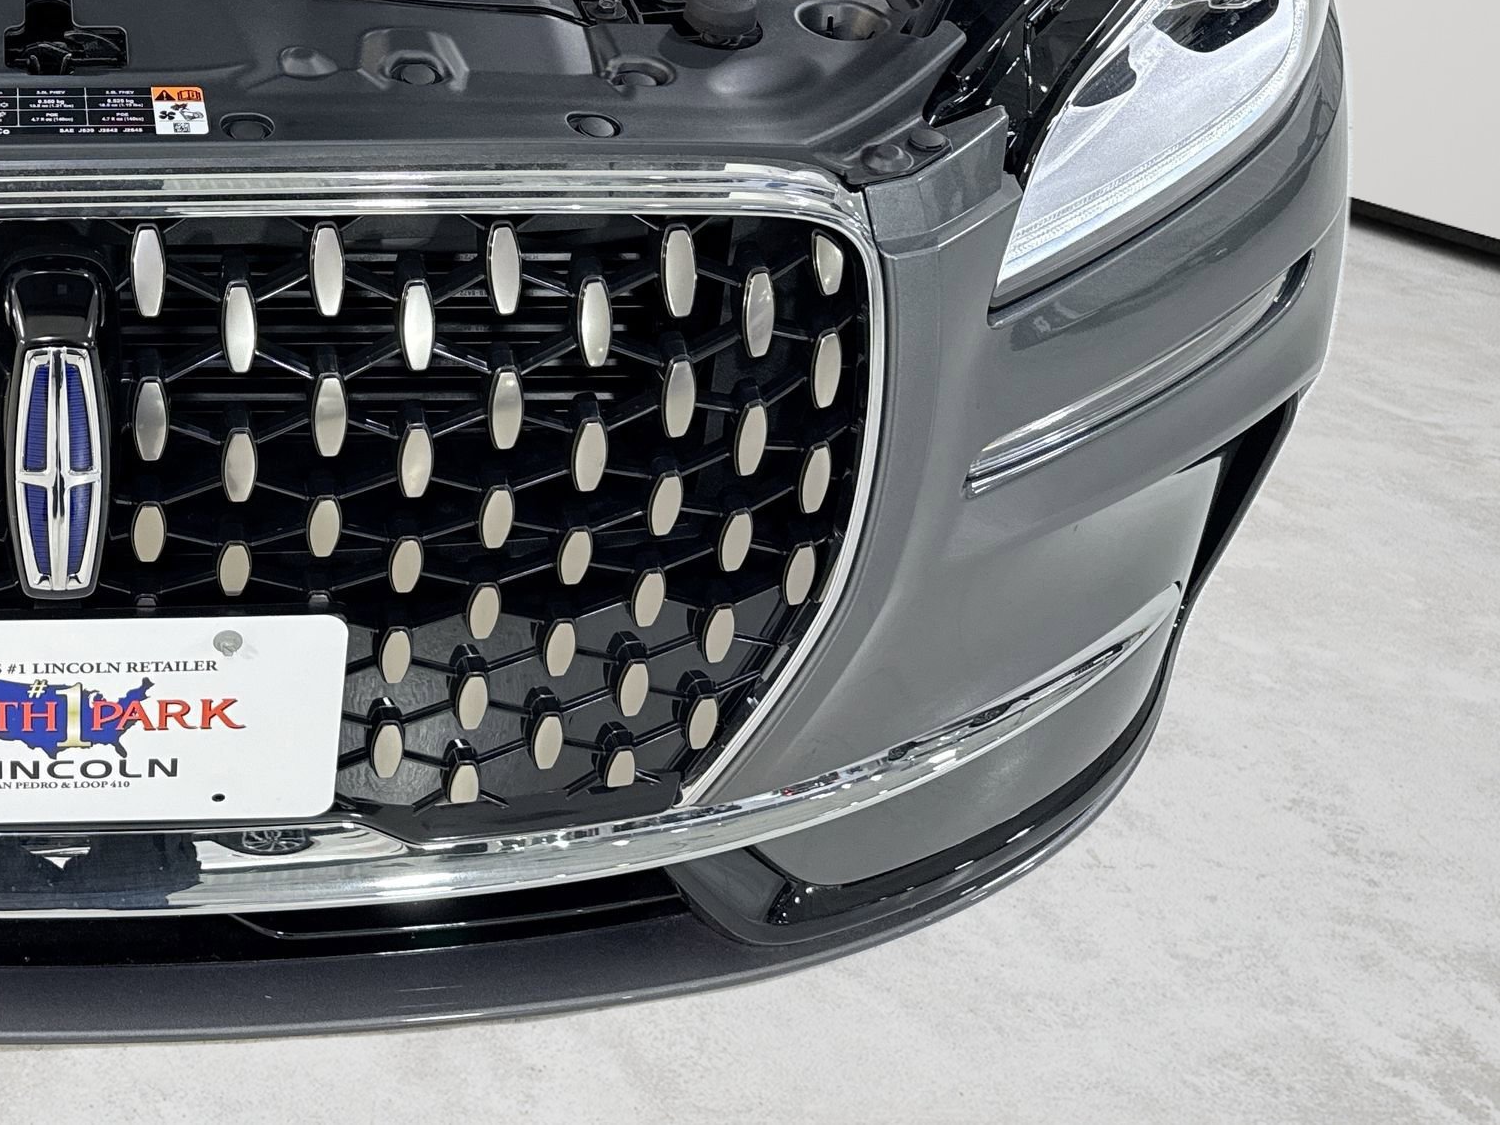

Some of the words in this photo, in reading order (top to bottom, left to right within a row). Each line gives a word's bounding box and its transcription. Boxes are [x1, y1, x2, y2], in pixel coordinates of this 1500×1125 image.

[7, 663, 26, 674] #1
[33, 661, 122, 674] LINCOLN
[126, 660, 219, 673] RETAILER
[91, 698, 247, 732] PARK
[15, 781, 58, 790] PEDRO
[60, 781, 71, 789] &
[73, 781, 109, 789] LOOP
[109, 780, 131, 789] 410
